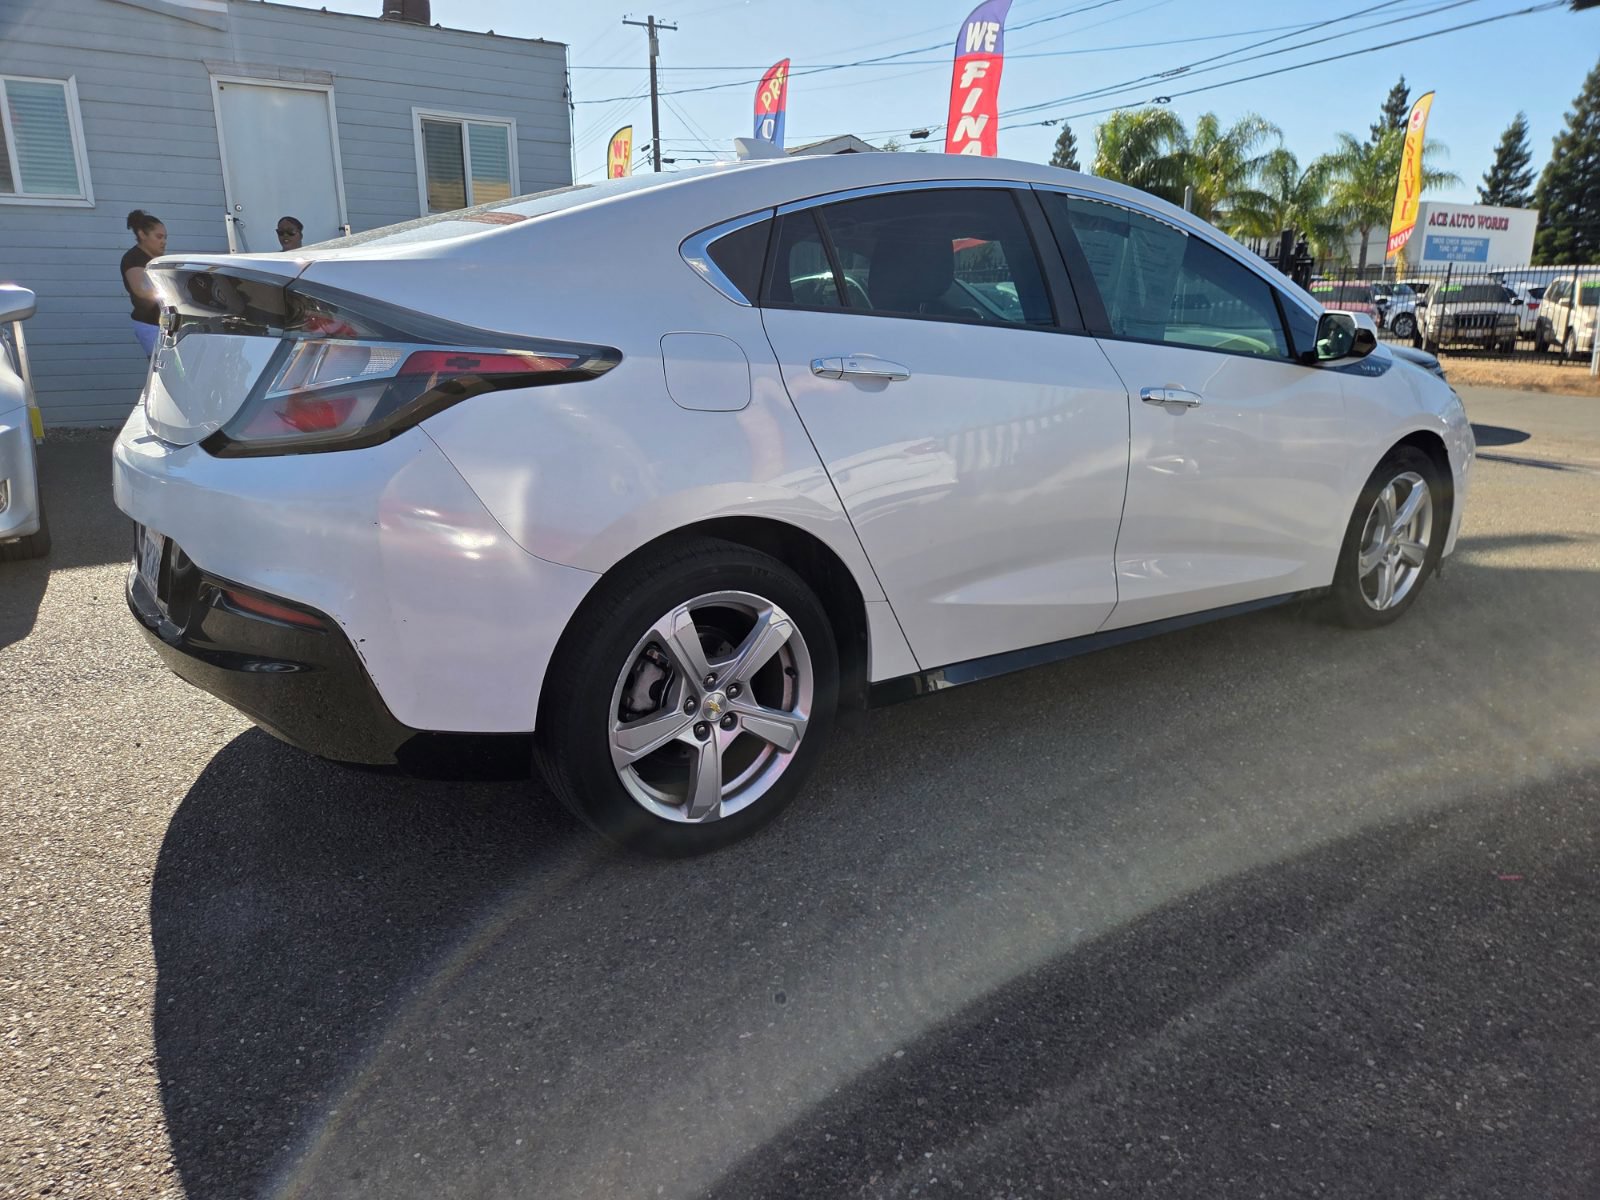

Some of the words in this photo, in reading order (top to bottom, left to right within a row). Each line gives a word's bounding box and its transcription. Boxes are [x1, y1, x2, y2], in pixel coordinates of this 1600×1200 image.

[965, 21, 1000, 53] WE
[612, 139, 630, 160] WE
[1428, 211, 1448, 227] ACE
[1449, 213, 1475, 228] AUTO
[1477, 214, 1509, 231] WORKS
